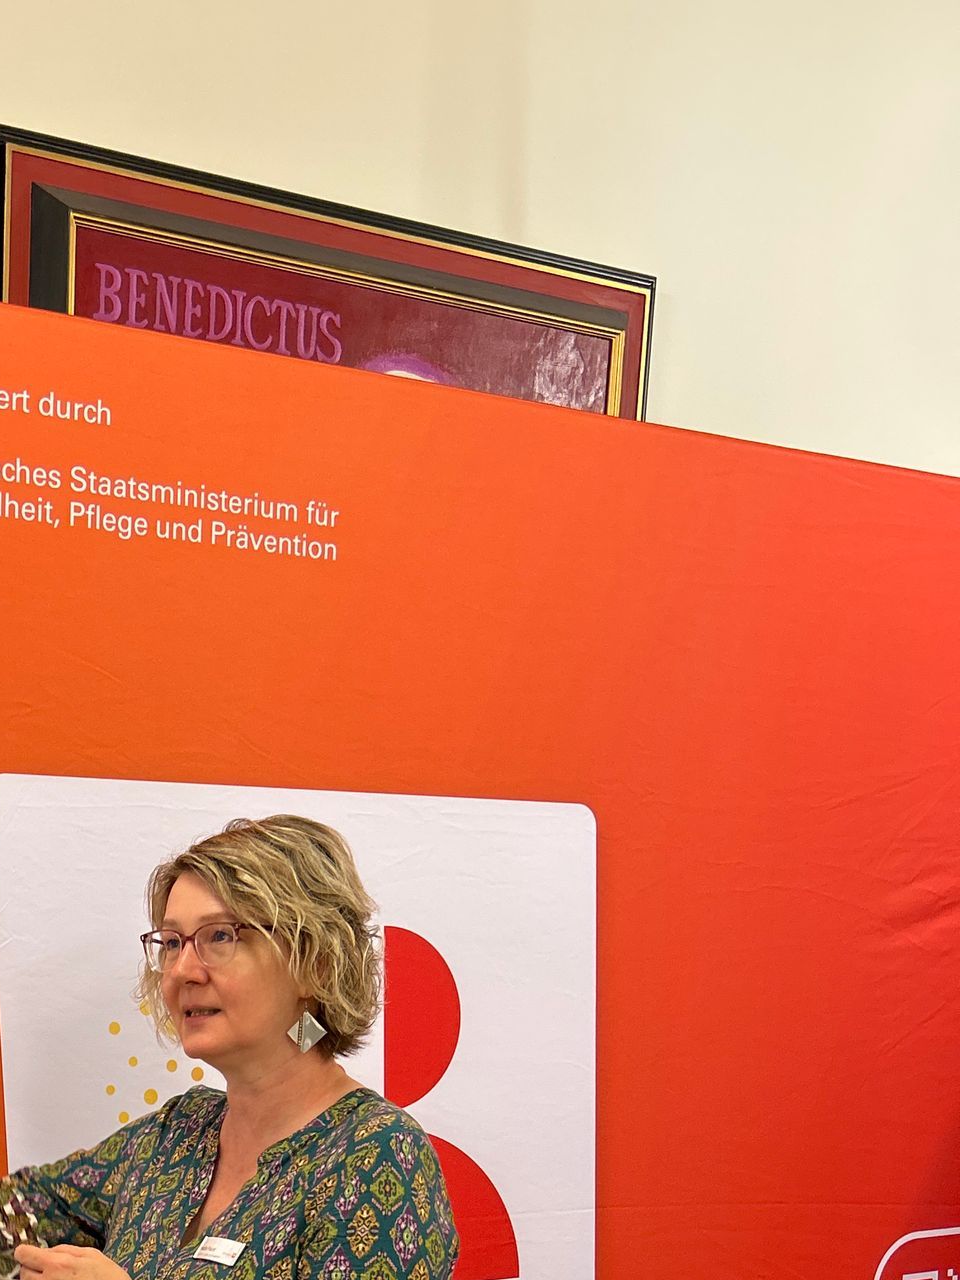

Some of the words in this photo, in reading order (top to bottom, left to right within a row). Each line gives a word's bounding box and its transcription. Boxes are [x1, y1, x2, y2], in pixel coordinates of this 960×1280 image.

[93, 262, 342, 364] BENEDICTUS
[39, 391, 111, 426] durch
[69, 465, 299, 522] Staatsministerium
[306, 500, 340, 528] für
[69, 501, 149, 540] Pflege
[156, 517, 203, 545] und
[211, 520, 338, 561] Prävention
